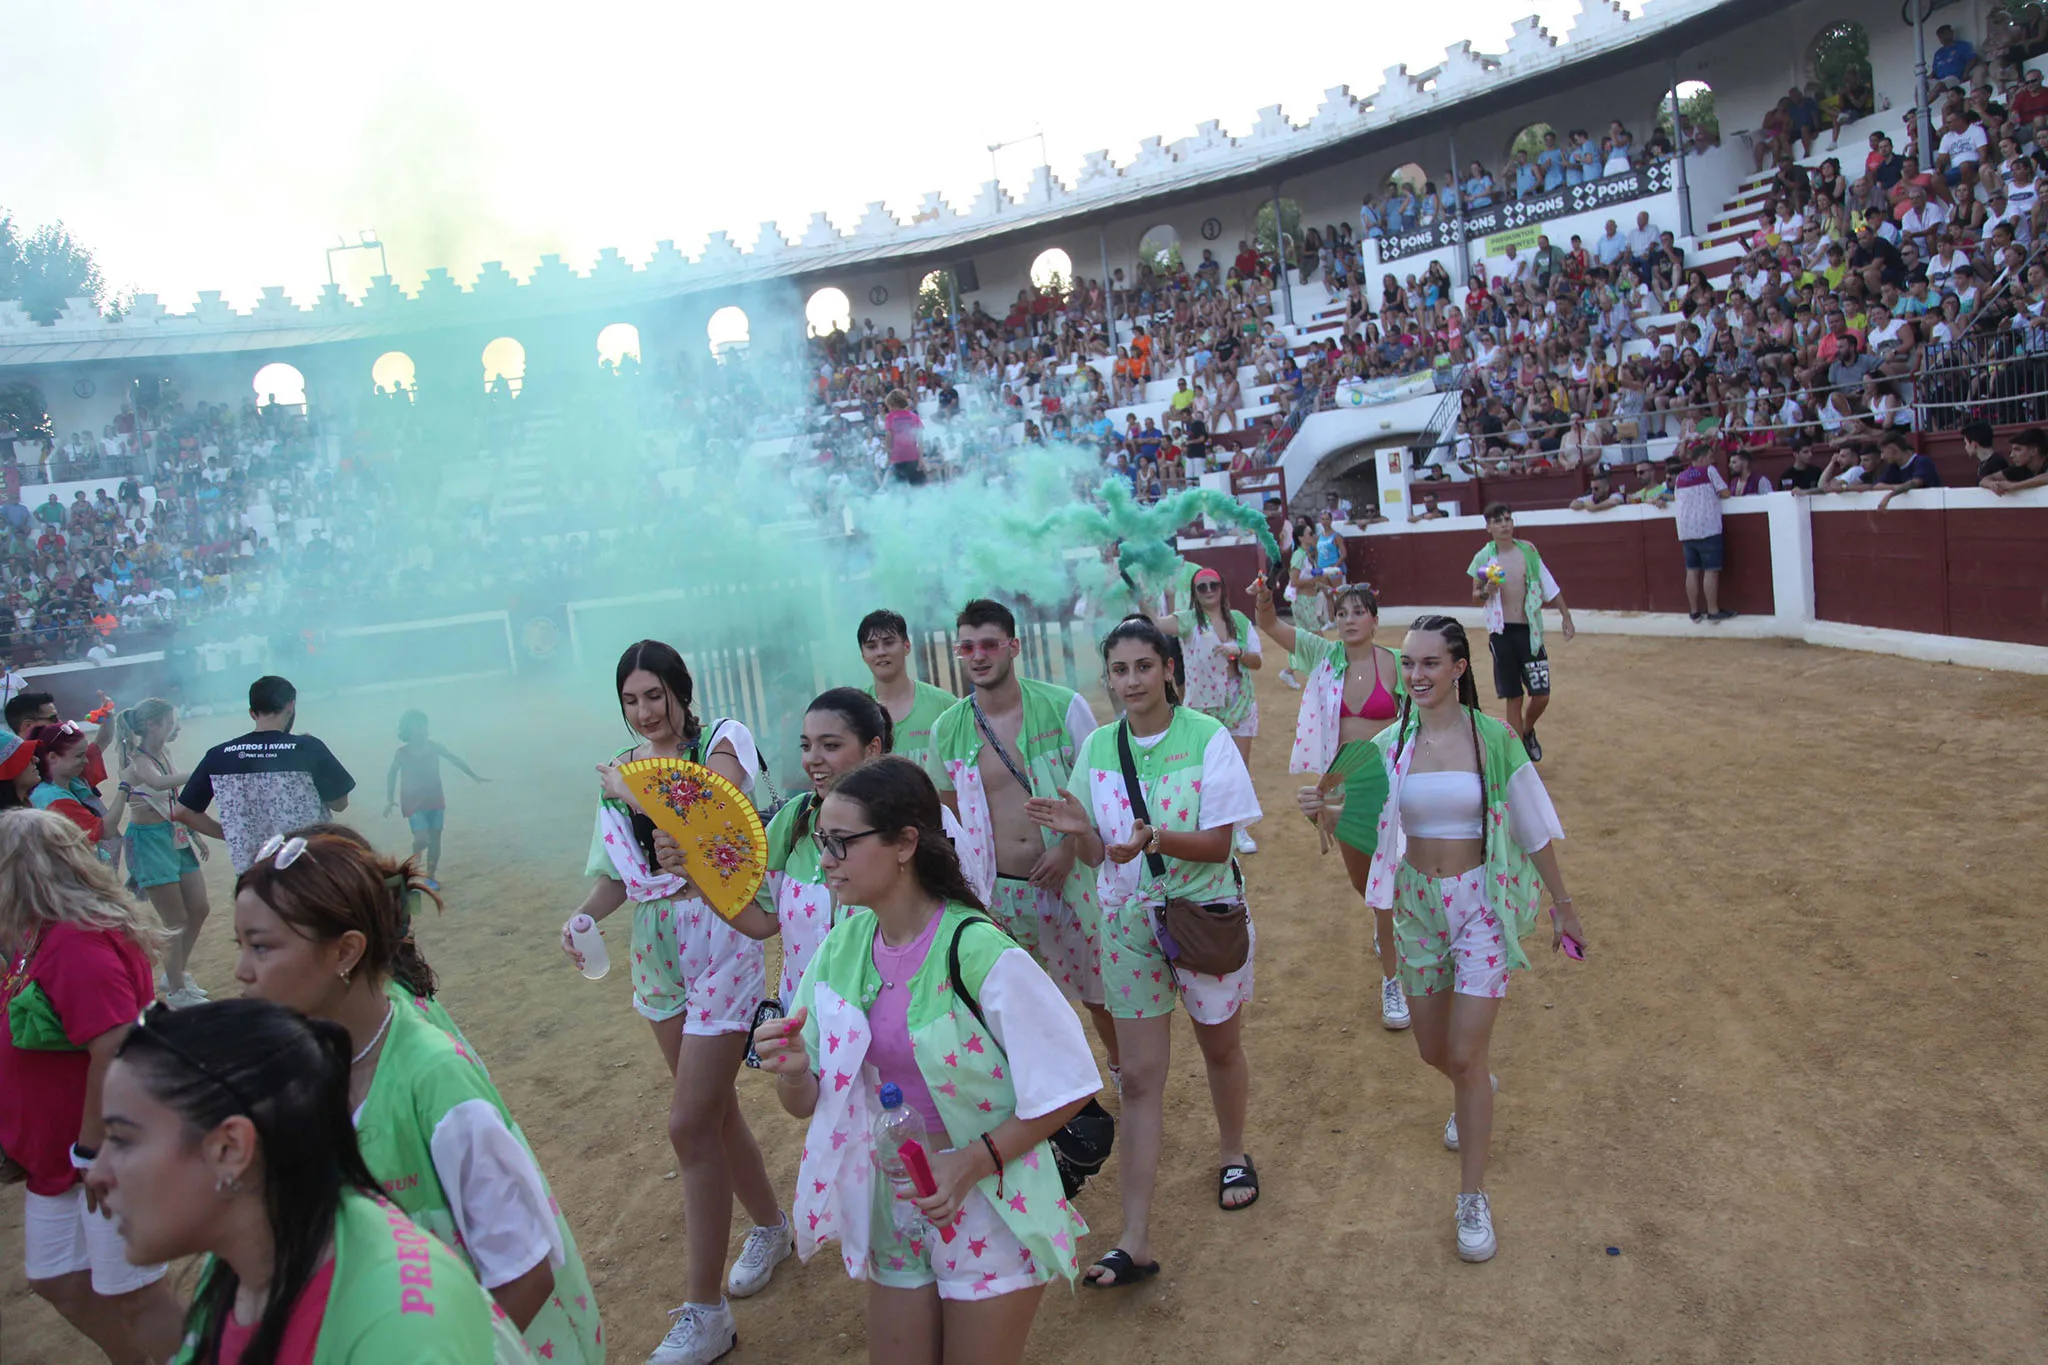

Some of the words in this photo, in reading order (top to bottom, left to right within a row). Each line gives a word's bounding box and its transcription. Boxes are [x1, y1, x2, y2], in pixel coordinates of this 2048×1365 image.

[1597, 177, 1639, 198] PONS
[1526, 196, 1565, 217] PONS
[1400, 231, 1433, 249] PONS
[1529, 670, 1549, 689] 23
[1226, 1168, 1244, 1177] NIKE
[384, 1173, 418, 1193] SUN
